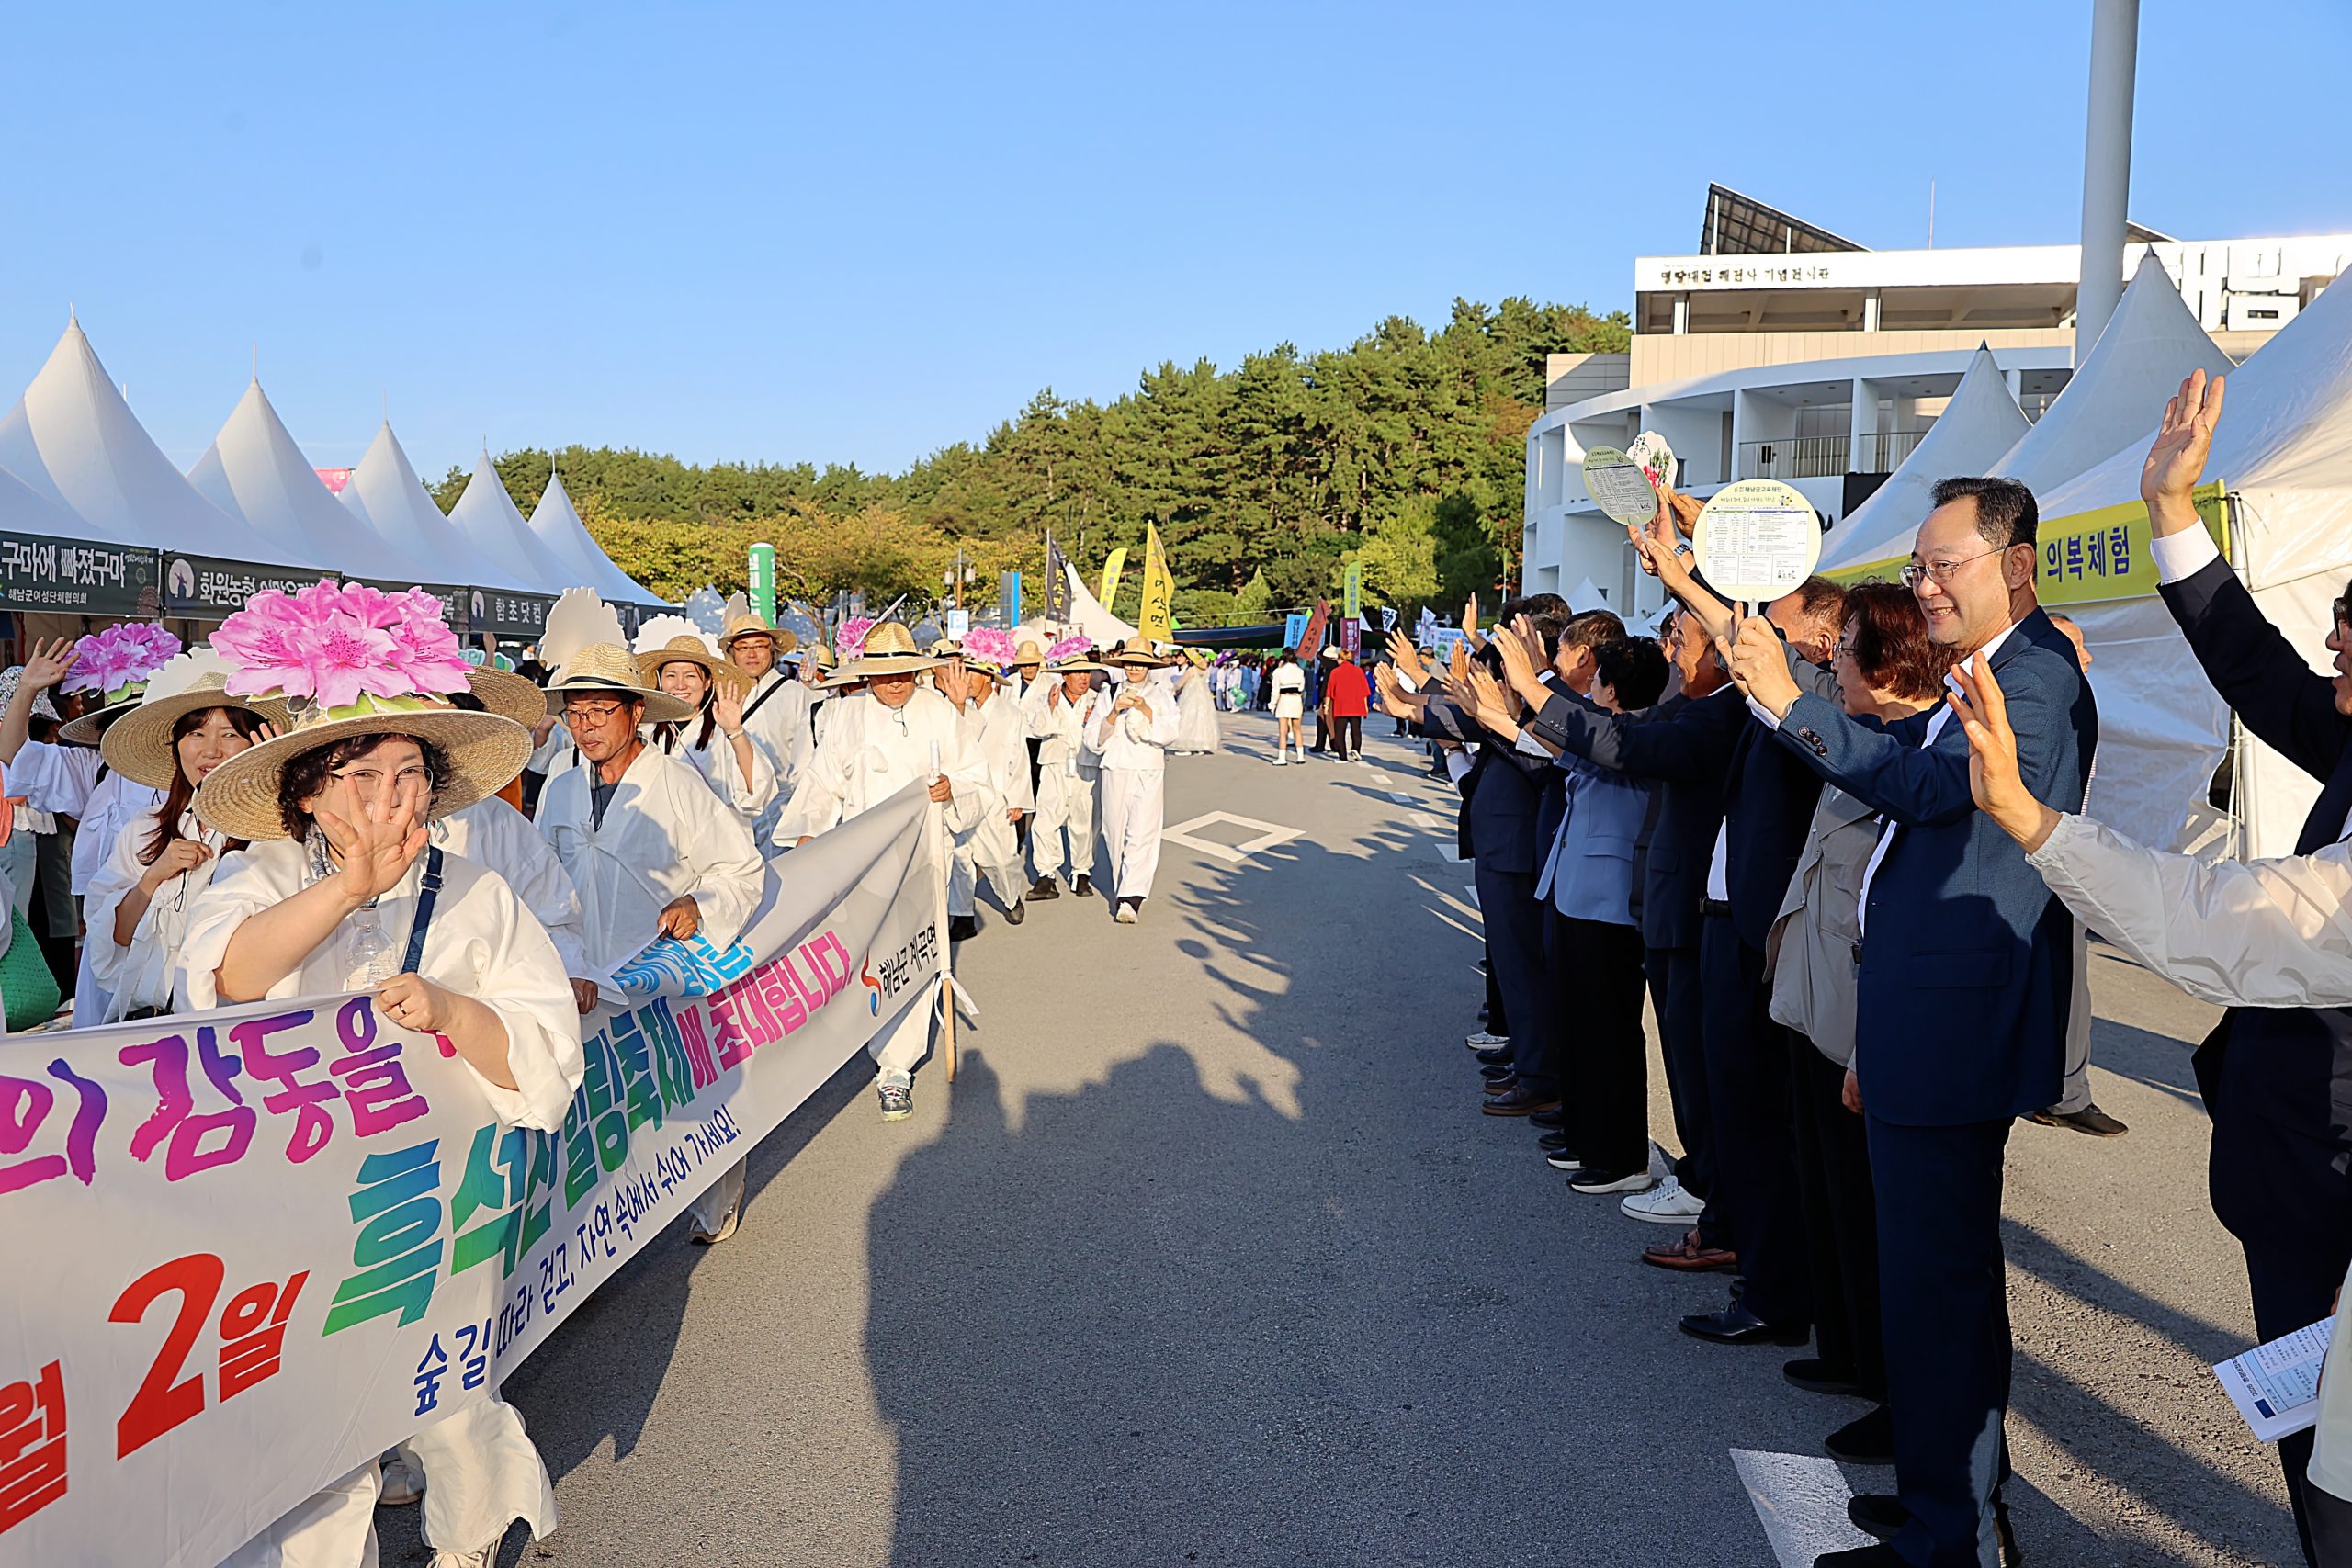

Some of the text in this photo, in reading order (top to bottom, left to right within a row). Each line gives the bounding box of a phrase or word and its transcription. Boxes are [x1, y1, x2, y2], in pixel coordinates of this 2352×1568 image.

[0, 541, 126, 589] 구마에 빠졌구마
[2046, 525, 2130, 583] 의복체험
[8, 588, 87, 605] 해남군여성단체협의회
[495, 597, 542, 626] 함초닷컴
[878, 921, 938, 999] 해남군 계곡면
[118, 996, 431, 1182] 감동을
[322, 1122, 560, 1337] 흑석산
[707, 929, 854, 1074] 초대합니다.
[413, 1102, 742, 1417] 숲길 따라 걷고, 자연 속에서 쉬어 가세요!
[107, 1253, 311, 1461] 2일
